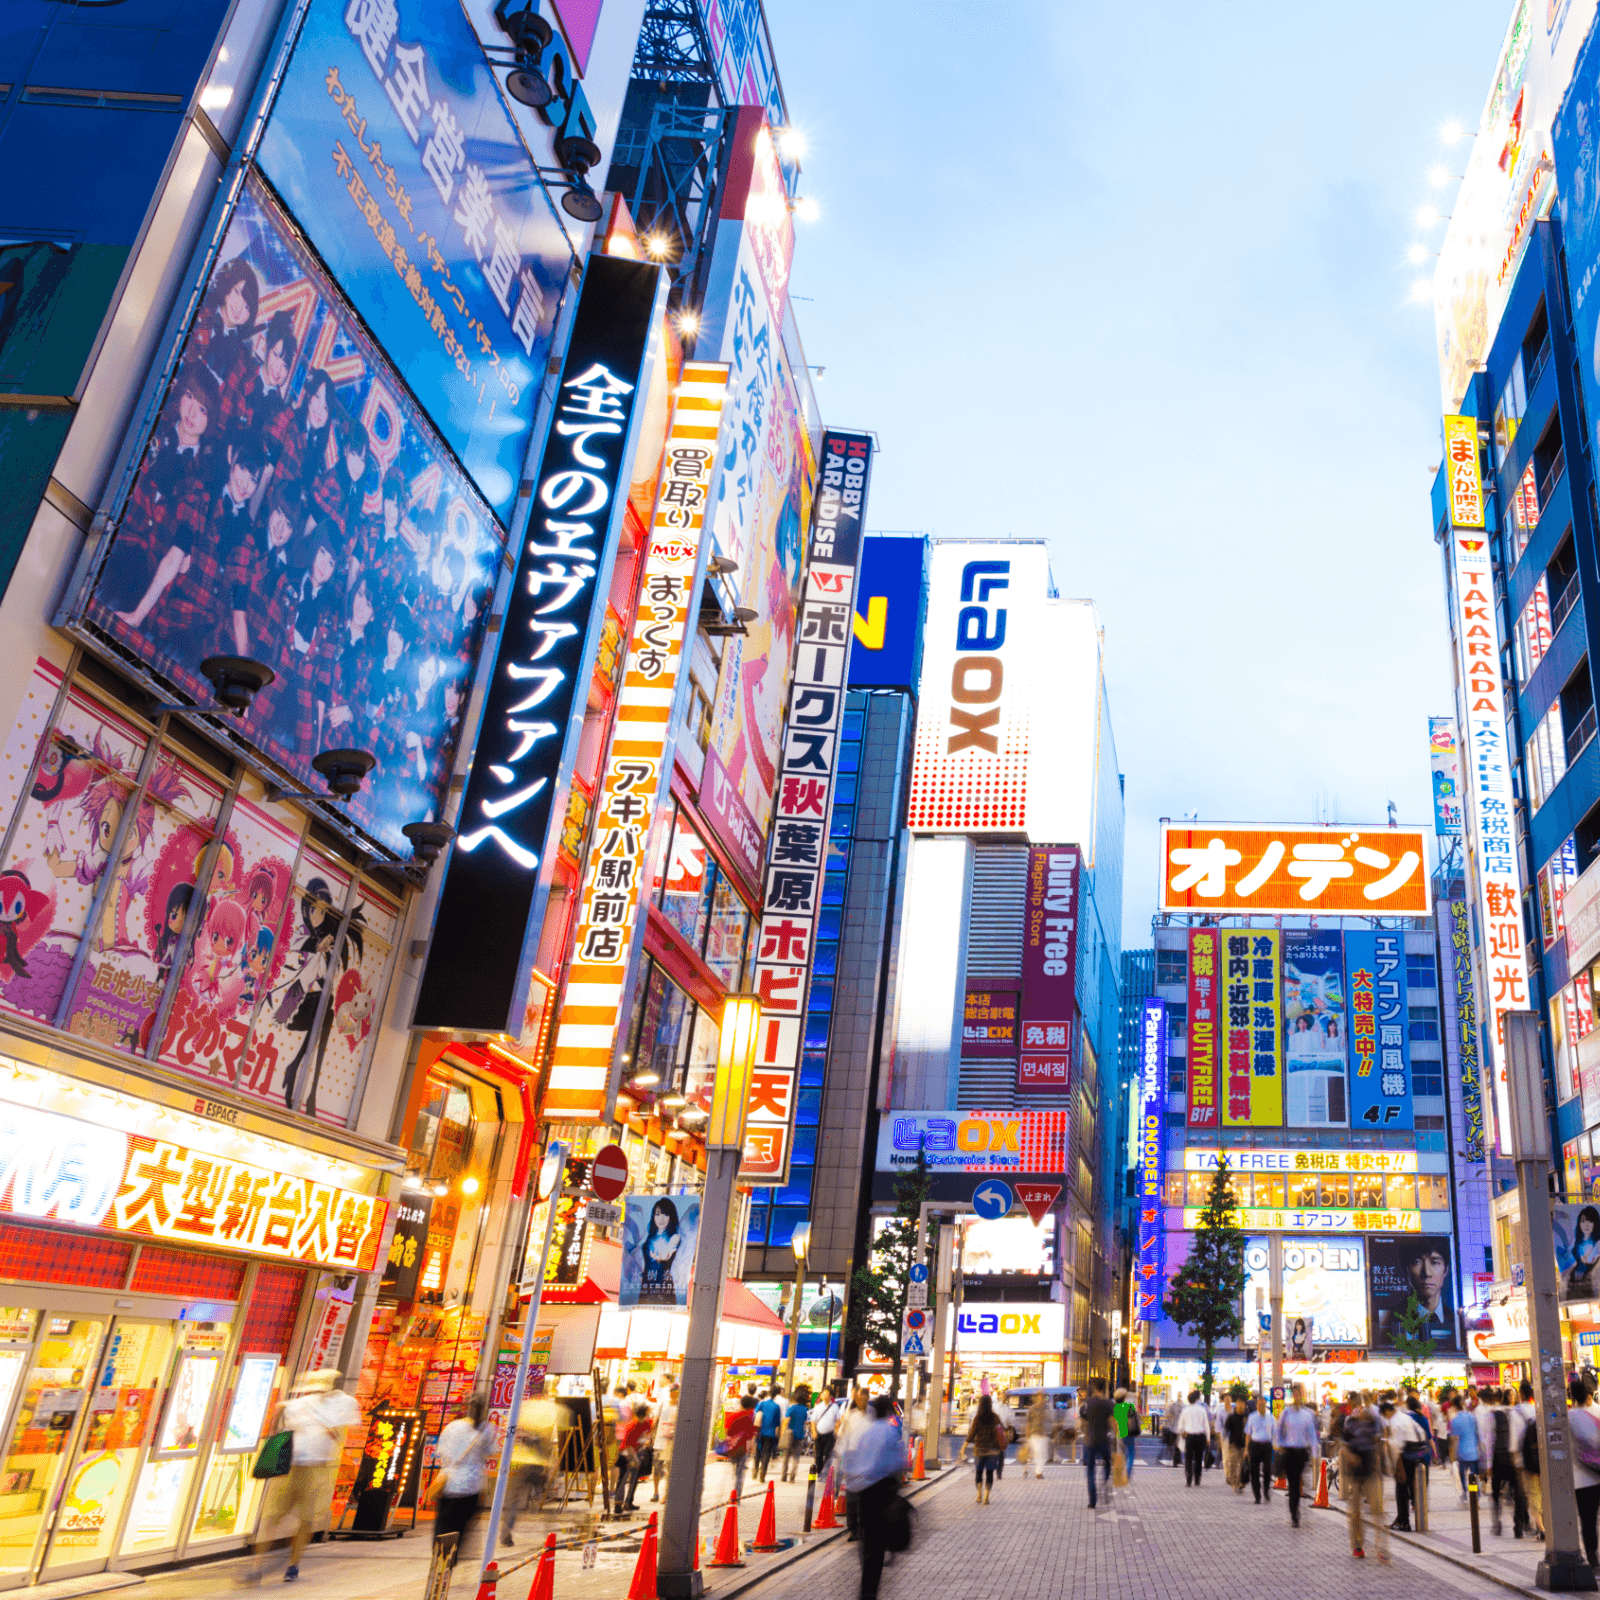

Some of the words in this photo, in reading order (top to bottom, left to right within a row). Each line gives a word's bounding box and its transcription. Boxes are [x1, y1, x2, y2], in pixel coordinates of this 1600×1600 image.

[663, 448, 709, 530] 買取り
[813, 438, 847, 558] PARADISE
[841, 440, 868, 520] HOBBY
[1451, 438, 1482, 524] まんが喫茶
[1461, 572, 1498, 712] TAKARADA
[585, 764, 650, 958] アキバ駅前店
[1479, 797, 1513, 874] 免税商店
[1031, 853, 1047, 906] Flagship
[1044, 853, 1077, 913] Duty
[1170, 833, 1420, 901] オノデン
[1030, 910, 1044, 947] Store
[1043, 918, 1074, 977] Free
[1192, 933, 1215, 976] 免税
[965, 994, 991, 1006] 本店
[1252, 936, 1276, 1077] 冷蔵庫洗濯機
[1376, 937, 1407, 1097] エアコン扇風機
[1026, 1026, 1066, 1046] 免税
[1145, 1007, 1162, 1103] Panasonic
[1192, 1022, 1214, 1106] DUTYFREE
[1022, 1062, 1066, 1078] 면세점
[206, 1102, 239, 1123] ESPACE
[1190, 1107, 1215, 1122] B1F
[1363, 1105, 1401, 1124] 4F
[990, 1154, 1020, 1165] Store
[1145, 1114, 1159, 1196] ONODEN
[1240, 1154, 1290, 1169] FREE
[1024, 1192, 1052, 1202] 止まれ
[1292, 1213, 1348, 1228] エアコン
[1141, 1208, 1158, 1308] オノデン
[1248, 1247, 1360, 1271] OODEN
